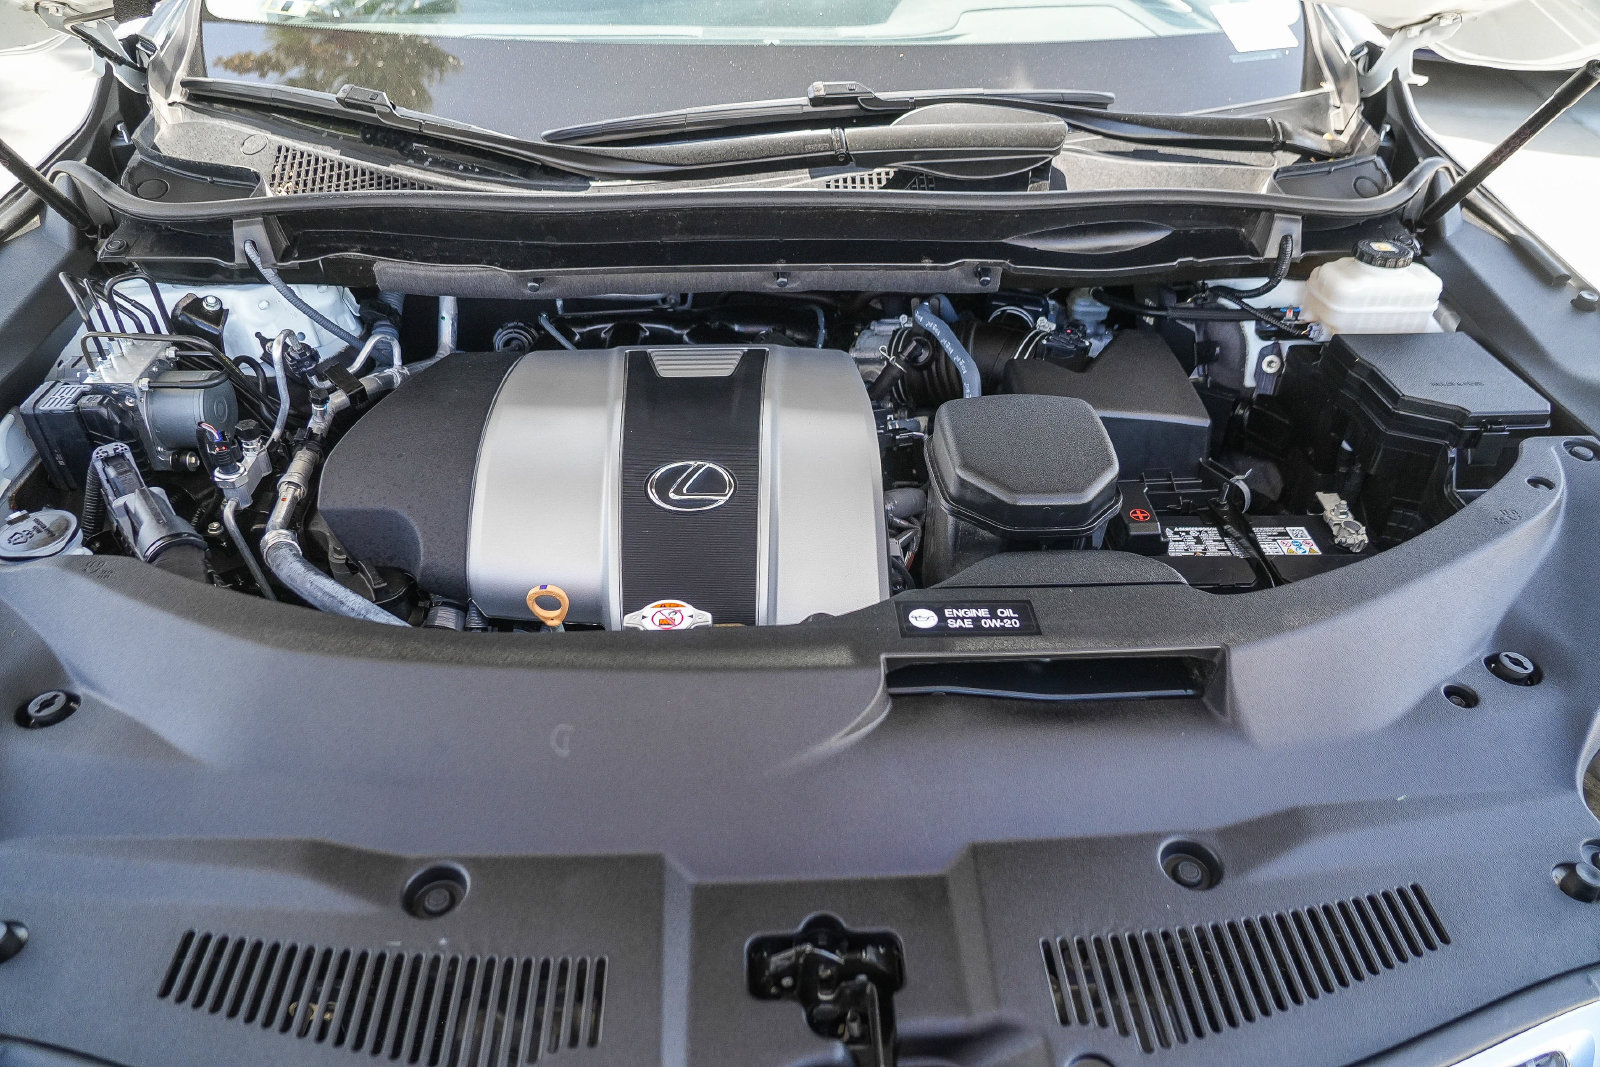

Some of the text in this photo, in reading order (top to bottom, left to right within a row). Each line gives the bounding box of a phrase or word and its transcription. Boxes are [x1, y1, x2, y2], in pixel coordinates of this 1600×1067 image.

[944, 608, 1018, 618] ENGINE OIL
[947, 618, 1020, 628] SAE 0W-20
